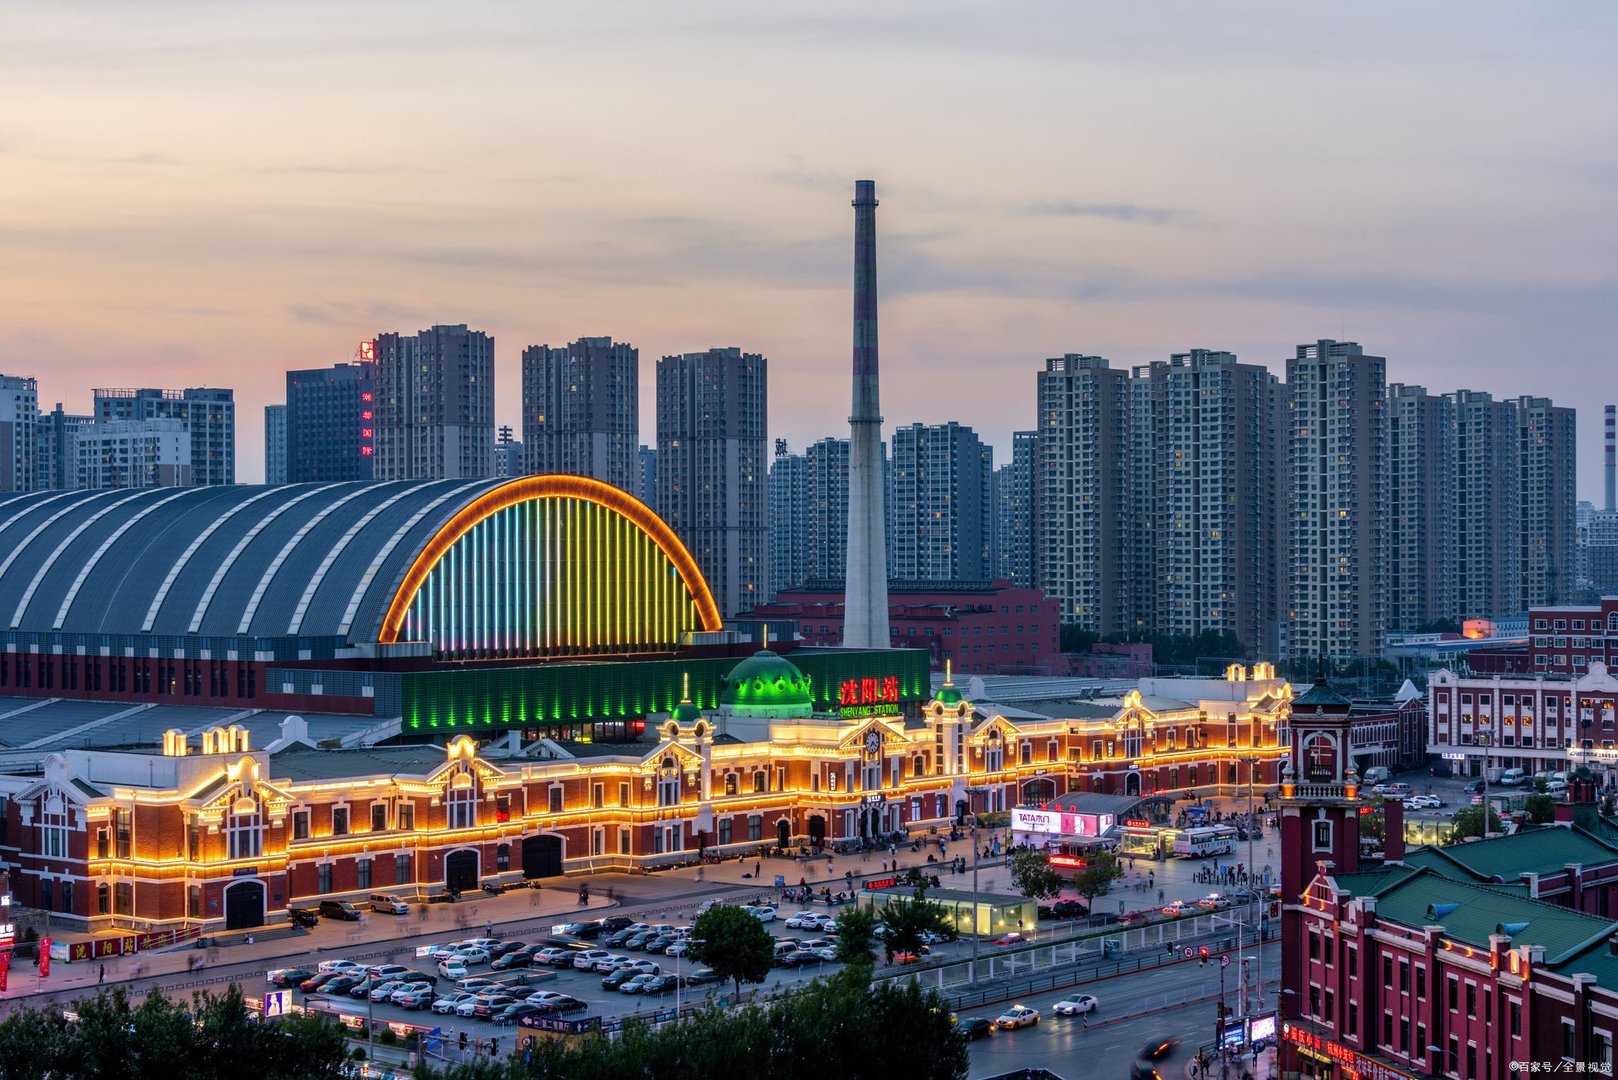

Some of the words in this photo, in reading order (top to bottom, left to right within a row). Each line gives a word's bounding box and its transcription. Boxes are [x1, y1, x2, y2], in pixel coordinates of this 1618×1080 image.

[840, 676, 898, 704] 沈阳站
[840, 705, 870, 717] SHENYANG
[874, 704, 898, 715] STATION
[1019, 813, 1050, 824] TATA木门
